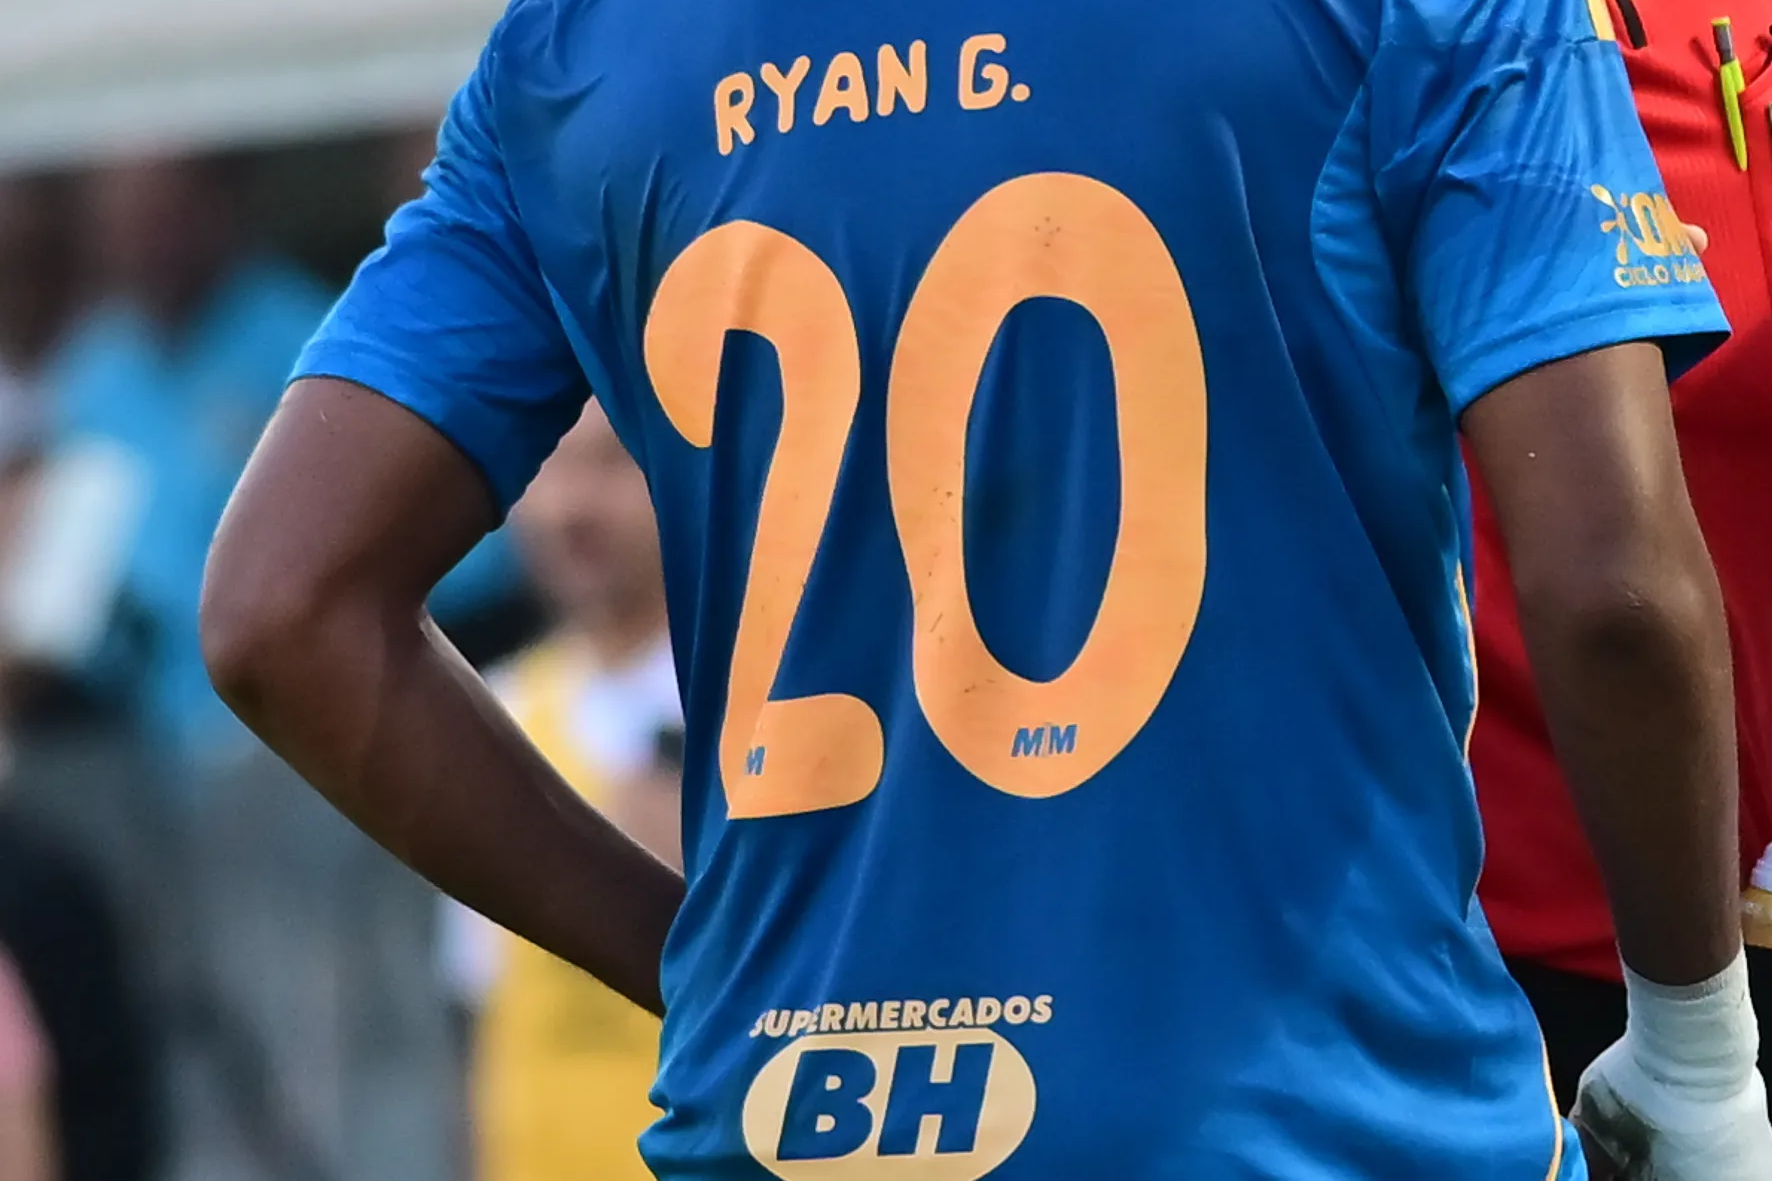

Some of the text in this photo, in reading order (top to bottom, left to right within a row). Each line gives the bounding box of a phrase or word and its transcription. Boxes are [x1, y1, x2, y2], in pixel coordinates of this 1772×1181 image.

[714, 33, 1031, 156] RYAN G.
[643, 172, 1208, 819] 20
[776, 1042, 995, 1160] BH
